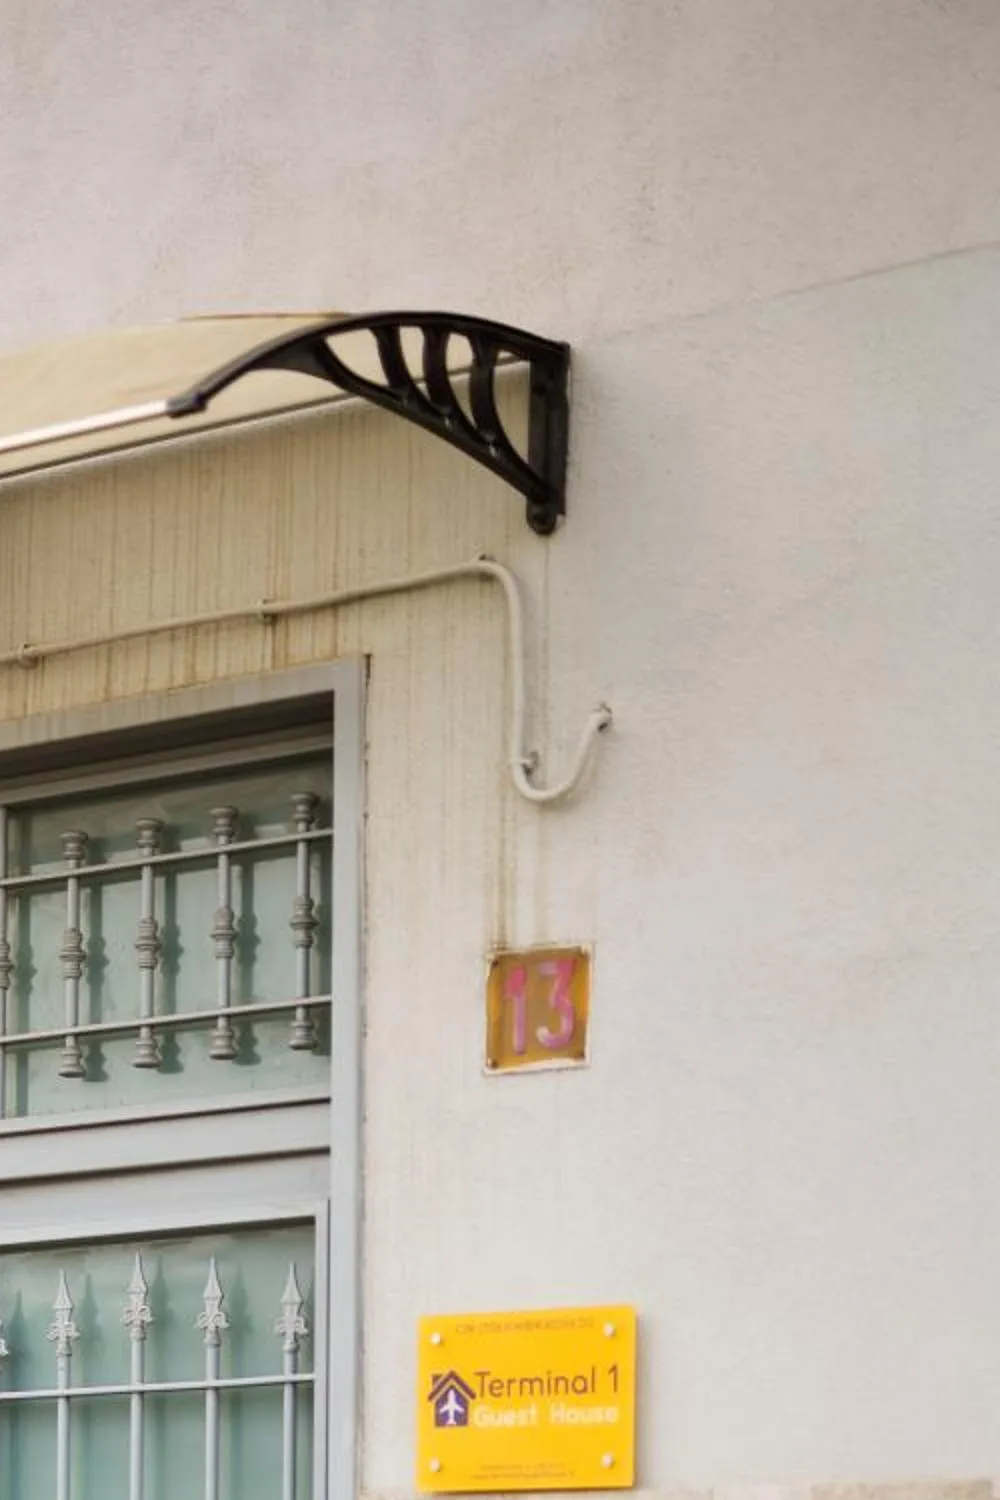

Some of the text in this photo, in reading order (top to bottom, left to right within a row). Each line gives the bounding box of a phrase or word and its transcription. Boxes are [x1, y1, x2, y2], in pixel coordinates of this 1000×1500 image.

[503, 957, 576, 1055] 13
[473, 1363, 620, 1398] Terminal 1
[474, 1402, 619, 1427] Guest House
